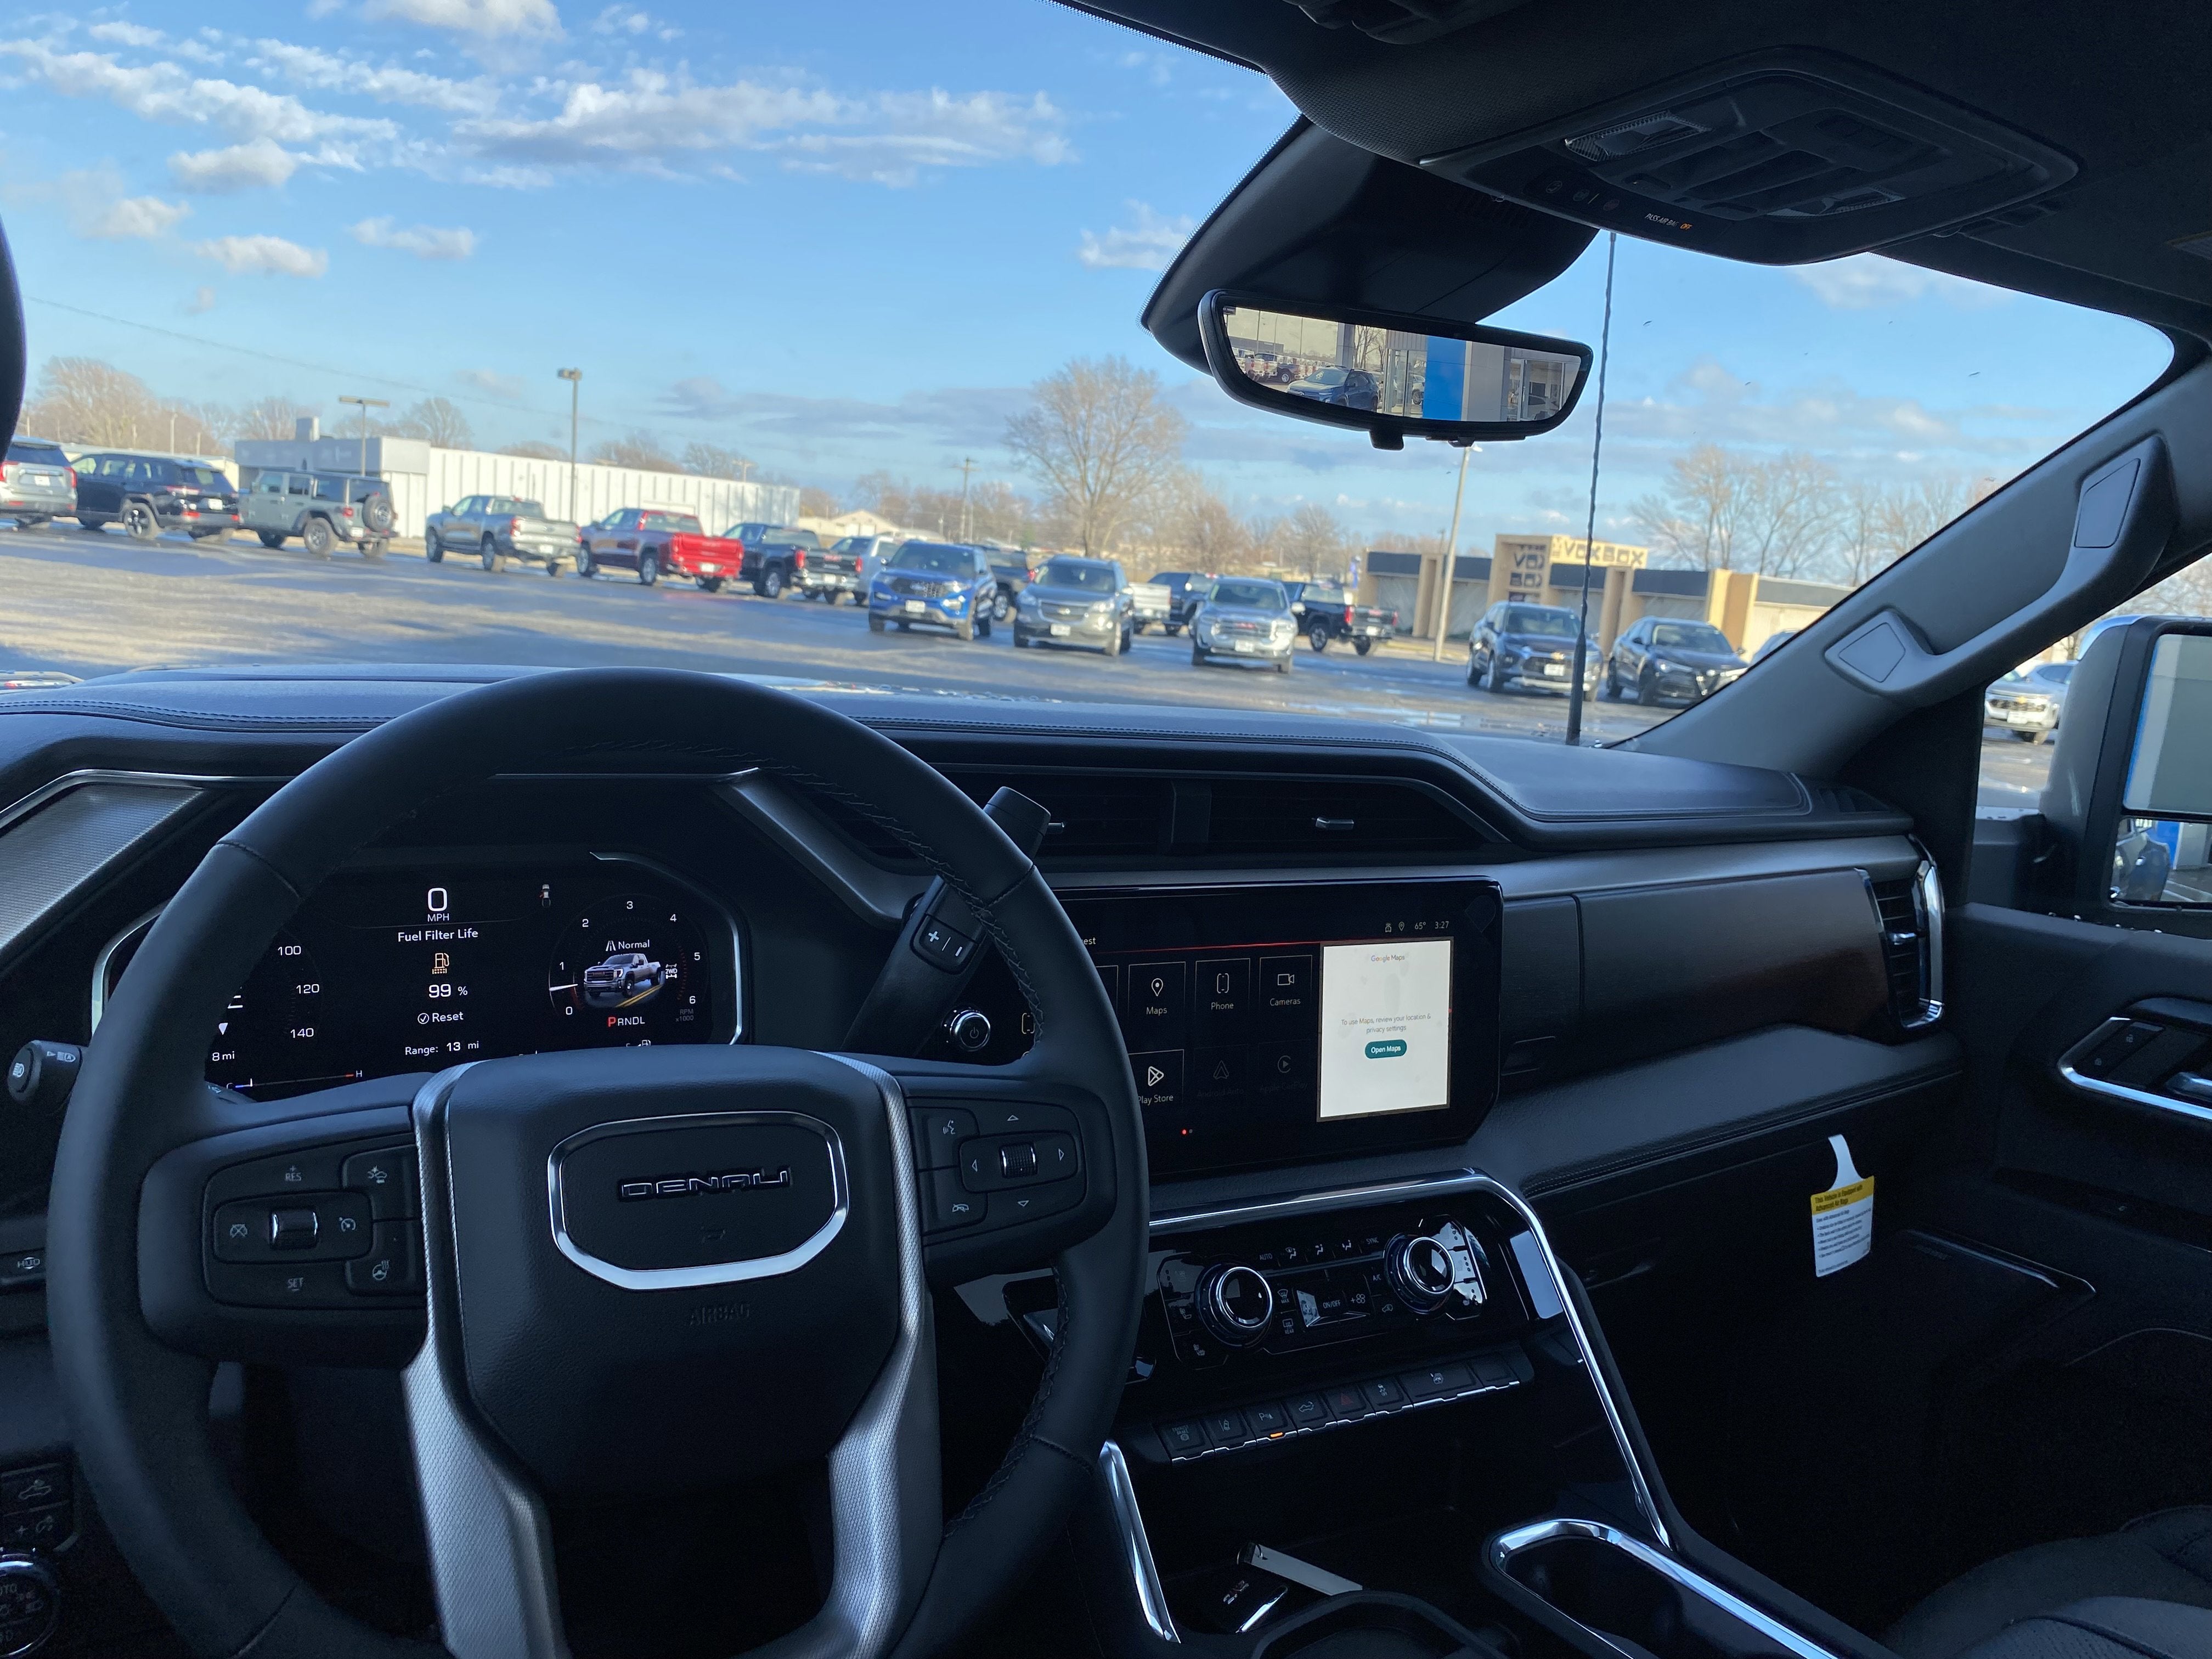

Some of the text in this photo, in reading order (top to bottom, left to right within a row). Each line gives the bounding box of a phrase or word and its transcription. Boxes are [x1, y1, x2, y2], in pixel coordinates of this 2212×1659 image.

[1644, 213, 1660, 222] PASS
[1657, 217, 1669, 225] AIR
[428, 888, 447, 911] 0
[627, 901, 633, 909] 3
[428, 913, 449, 922] MPH
[583, 919, 589, 927] 2
[1435, 921, 1449, 929] 3:27
[398, 928, 478, 941] Fuel Filter Life
[618, 939, 650, 949] Normal
[278, 946, 301, 955] 100
[560, 962, 563, 970] 1
[296, 984, 319, 994] 120
[429, 984, 467, 998] 99 %
[690, 996, 696, 1004] 6
[566, 1007, 572, 1015] 0
[1147, 1007, 1167, 1015] Maps
[432, 1012, 464, 1022] Reset
[291, 1028, 314, 1038] 140
[405, 1041, 478, 1056] Range: 13 mi
[222, 1051, 234, 1060] mi
[285, 1173, 302, 1181] RES
[622, 1169, 789, 1198] DENALI
[287, 1278, 303, 1286] SET
[1323, 1300, 1341, 1309] ON/OFF
